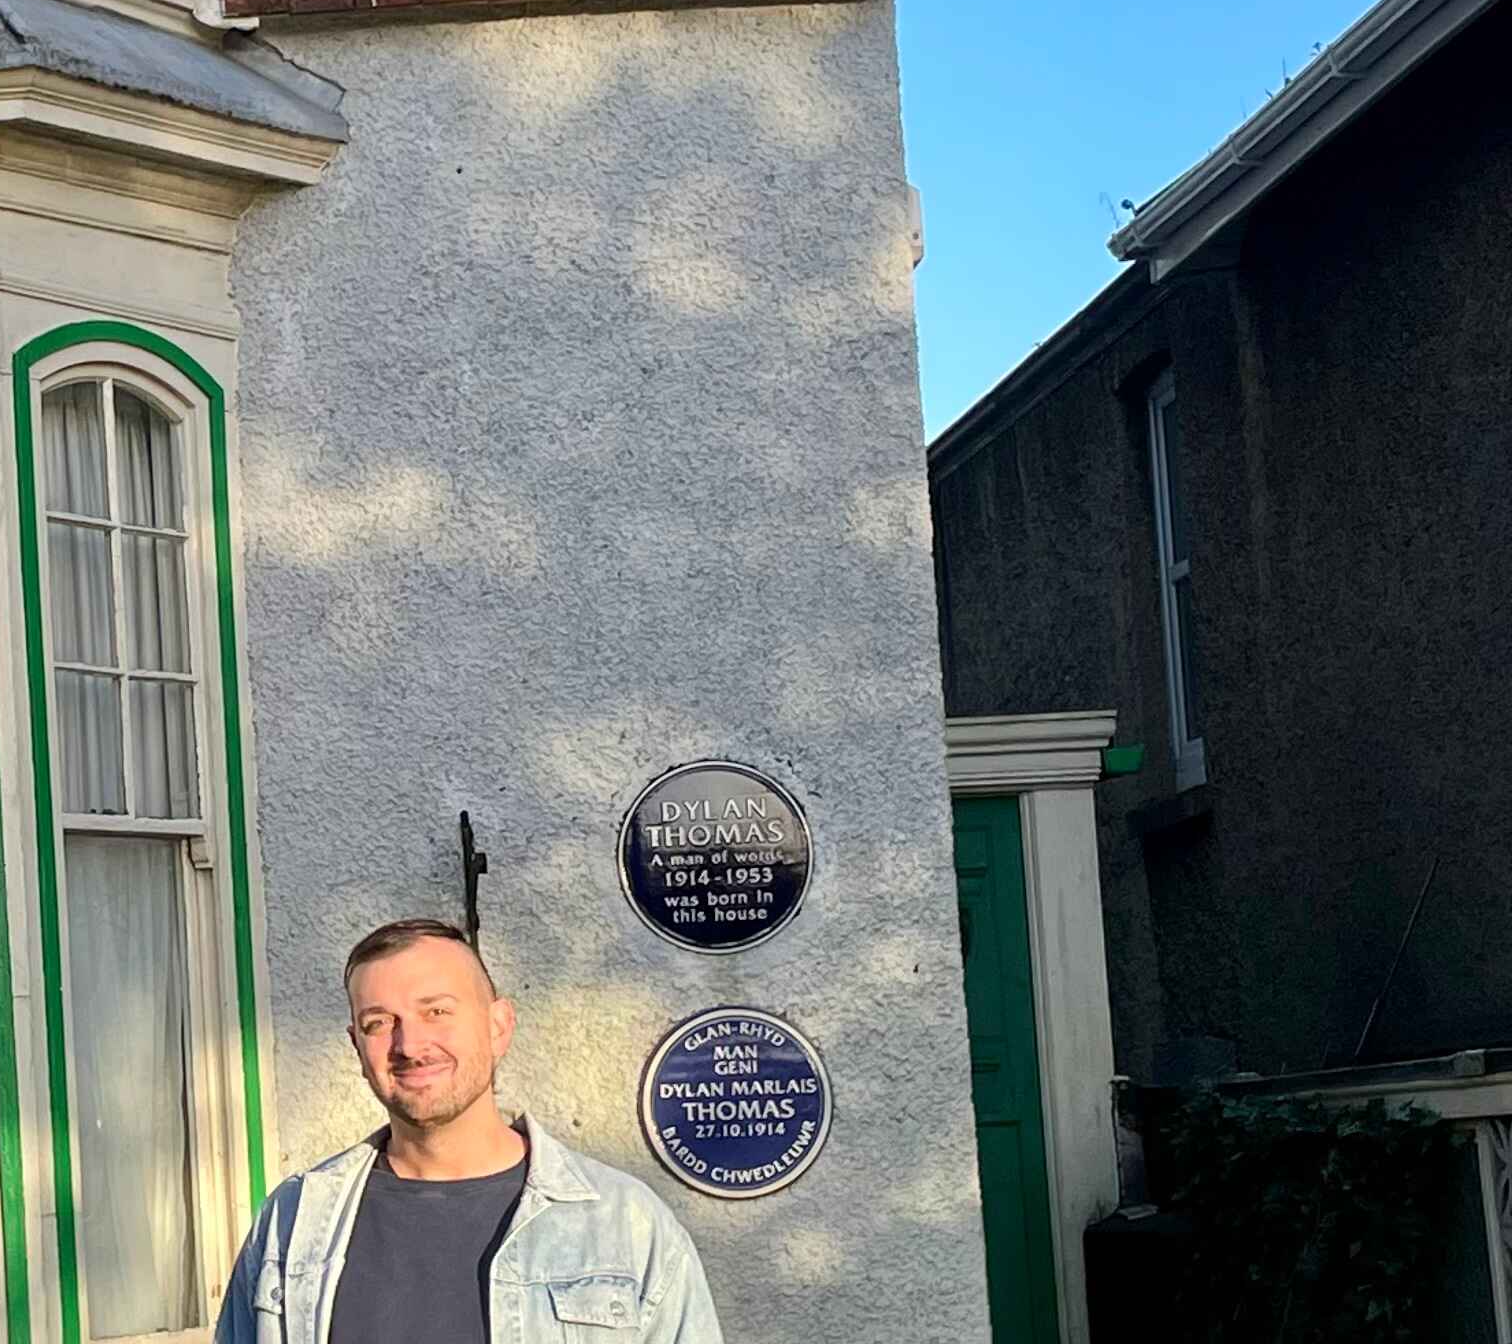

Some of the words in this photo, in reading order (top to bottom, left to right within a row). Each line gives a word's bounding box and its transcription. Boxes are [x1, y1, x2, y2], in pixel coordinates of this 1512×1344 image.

[662, 799, 768, 822] DYLAN
[645, 819, 784, 847] THOMAS
[651, 855, 663, 866] A
[670, 854, 703, 866] man
[712, 850, 727, 864] of
[665, 868, 774, 887] 1914-1953
[664, 896, 699, 907] was
[707, 892, 748, 906] born
[757, 890, 774, 904] in
[673, 910, 706, 923] this
[715, 908, 768, 922] house
[684, 1022, 785, 1051] GLAN-RHYD
[714, 1045, 758, 1061] MAN
[715, 1061, 758, 1076] GENI
[660, 1082, 724, 1099] DYLAN
[731, 1078, 817, 1095] MARLAIS
[682, 1100, 795, 1122] THOMAS
[695, 1122, 786, 1138] 27.10.1914
[662, 1126, 708, 1174] BARDD
[711, 1119, 817, 1184] CHWEDLEUWR
